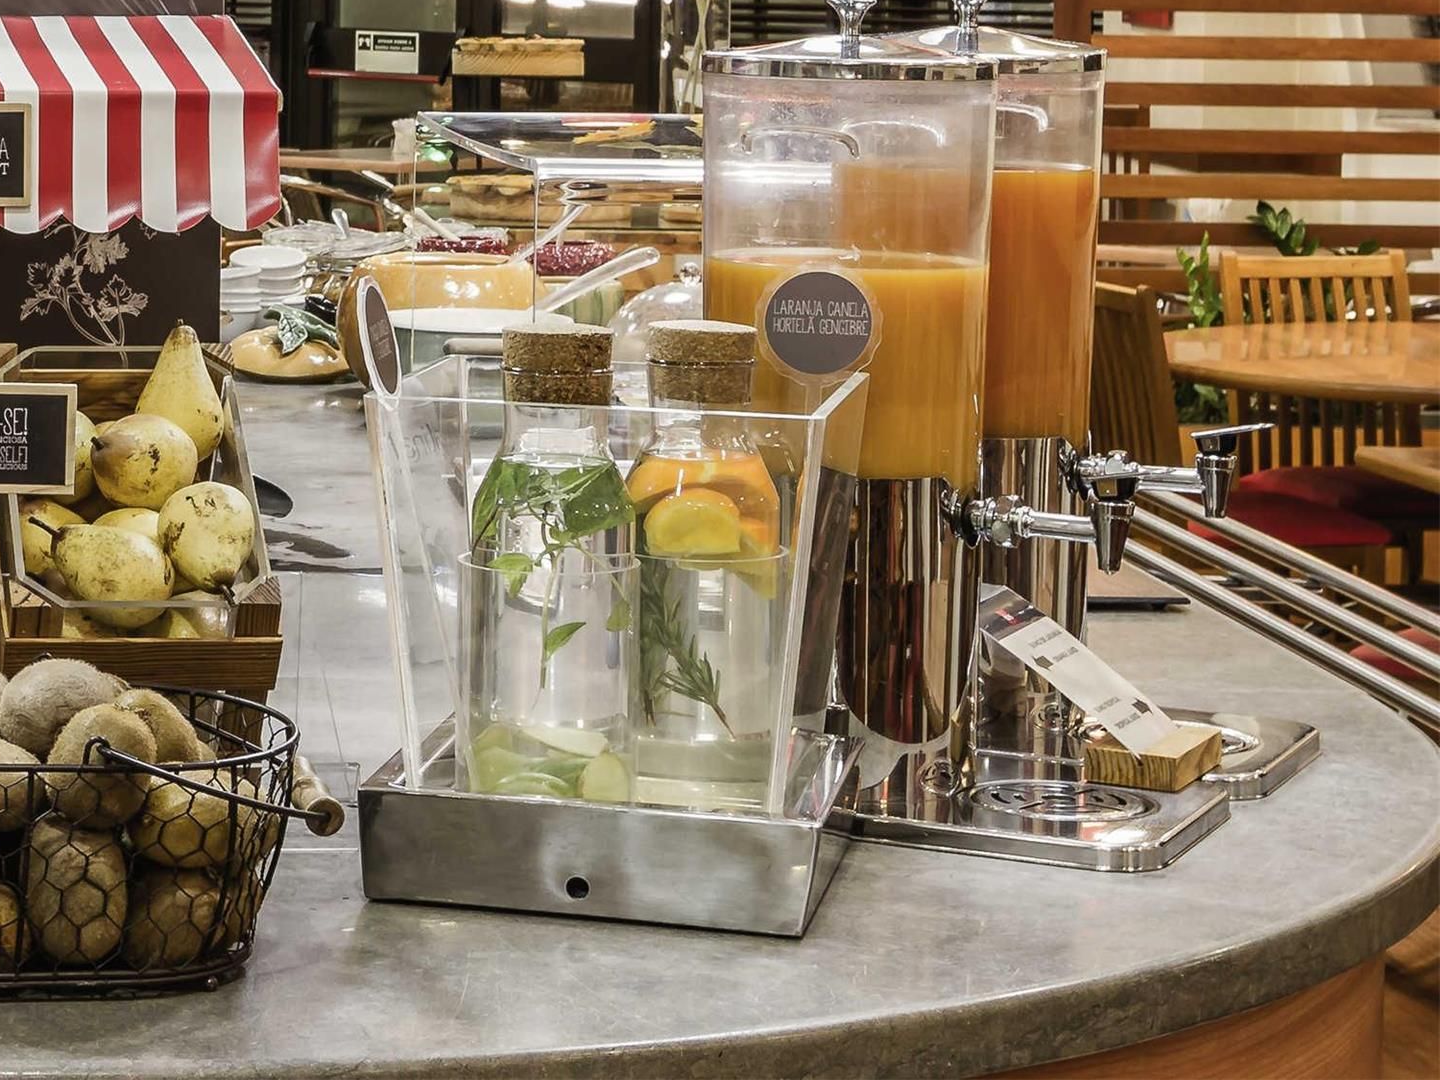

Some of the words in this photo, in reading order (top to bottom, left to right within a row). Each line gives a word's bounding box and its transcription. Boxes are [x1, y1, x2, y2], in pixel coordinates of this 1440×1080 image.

[772, 299, 824, 317] LARANJA
[827, 300, 869, 319] CANELA
[818, 319, 869, 336] GENGIBRE
